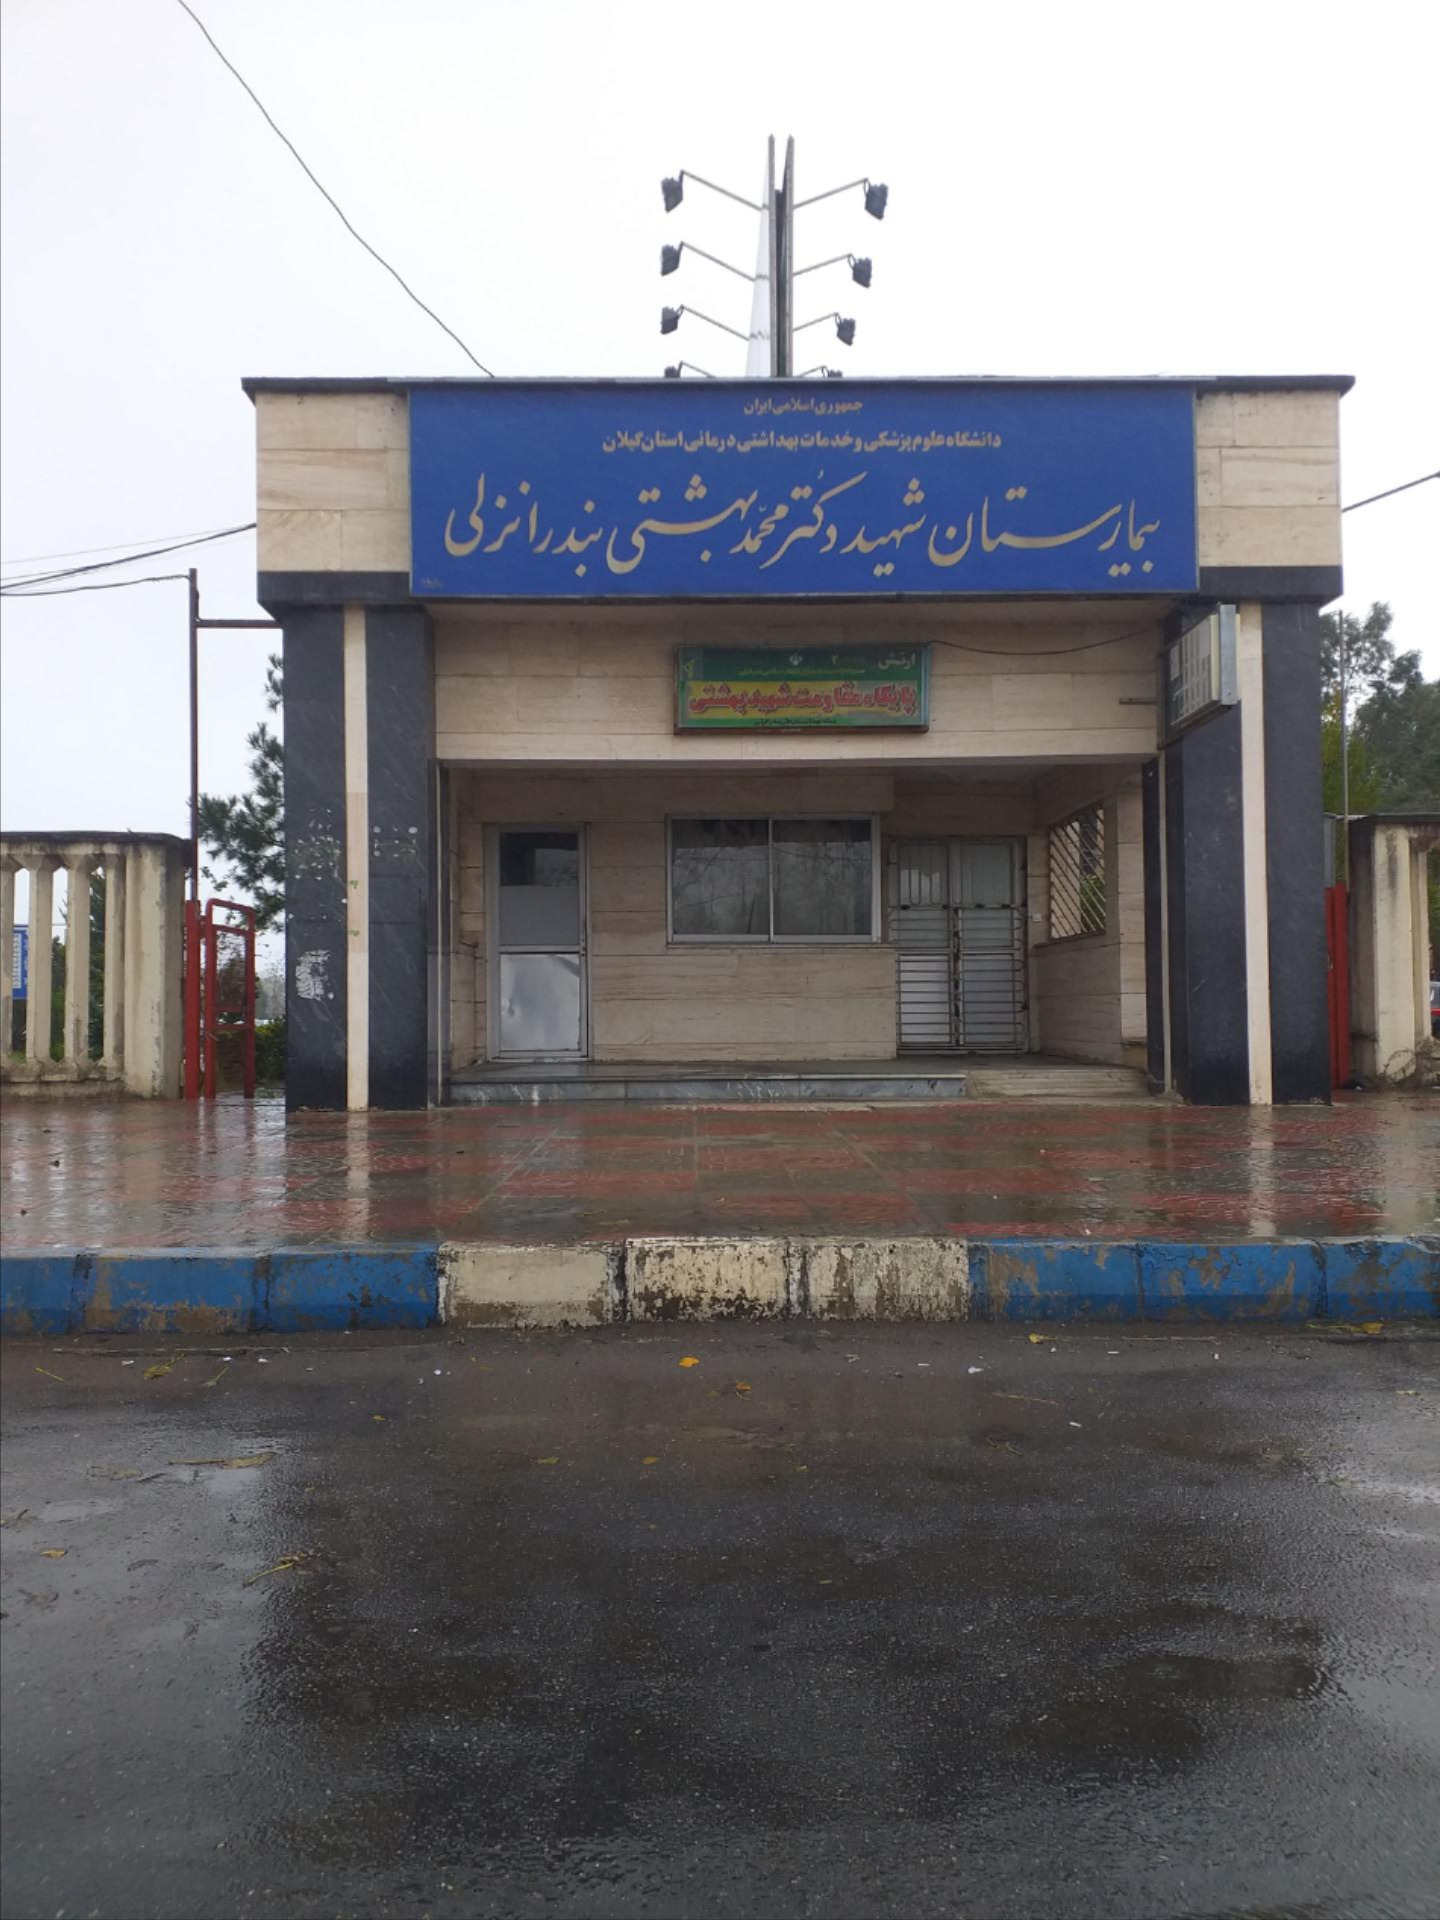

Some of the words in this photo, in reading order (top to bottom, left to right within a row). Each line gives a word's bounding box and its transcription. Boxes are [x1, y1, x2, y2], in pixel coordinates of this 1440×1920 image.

[743, 398, 772, 416] ایران
[772, 398, 814, 416] اسلامی
[815, 400, 864, 416] جمهوری
[602, 430, 643, 452] گیلان
[641, 430, 683, 452] استان
[683, 430, 736, 452] درمانی
[737, 430, 799, 452] بهداشتی
[800, 430, 853, 448] خدمات
[853, 436, 863, 452] و
[864, 430, 912, 452] پزشکی
[912, 430, 946, 452] علوم
[946, 430, 1002, 448] دانشگاه
[606, 473, 759, 575] بهشتی
[839, 477, 927, 577] شهید
[927, 485, 1161, 577] بیمارستان
[688, 683, 748, 716] بهشتی
[747, 683, 791, 715] شهید
[790, 680, 862, 714] مقاومت
[862, 683, 918, 717] پایگاه
